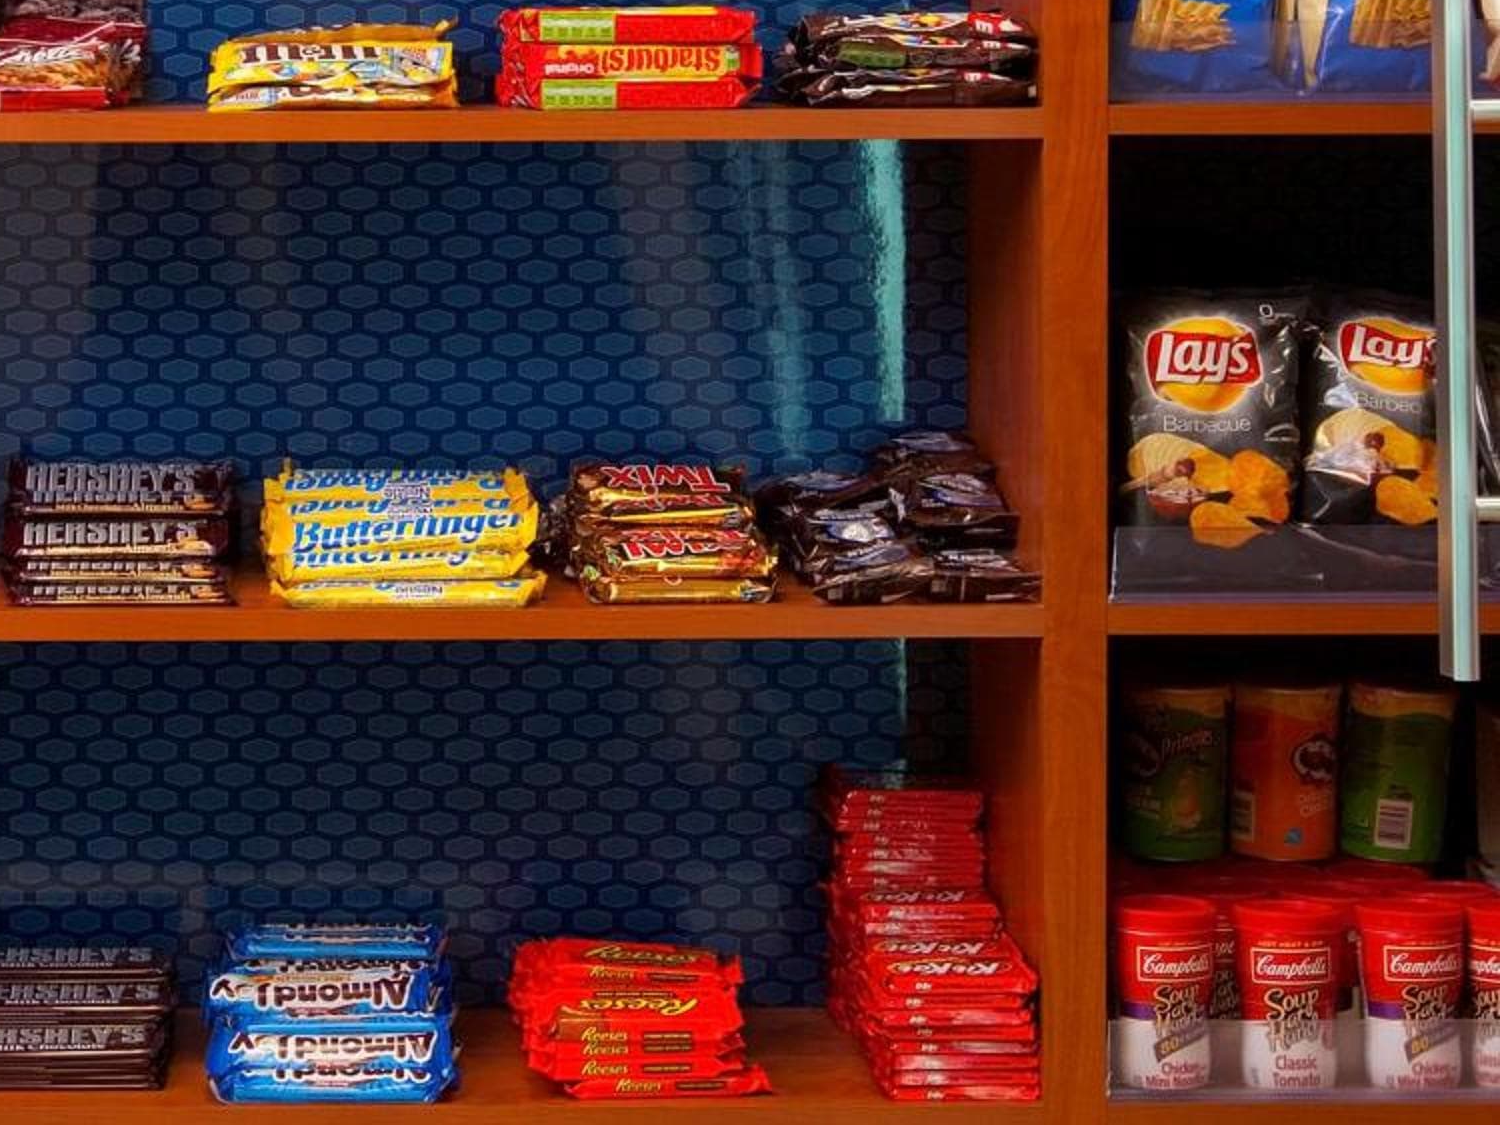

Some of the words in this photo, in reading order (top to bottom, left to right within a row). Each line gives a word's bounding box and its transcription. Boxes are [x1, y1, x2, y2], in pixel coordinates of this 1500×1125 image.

[600, 46, 722, 74] Starburst
[1155, 332, 1253, 385] Lay's
[1163, 415, 1252, 434] Barbecue
[25, 463, 196, 492] HERSHEY'S
[600, 464, 731, 492] TWIX
[23, 521, 199, 546] HERSHEY'S
[293, 513, 521, 554] Butterfinger
[273, 976, 413, 1009] Almond
[1154, 985, 1200, 1011] Soup
[1263, 988, 1320, 1020] Soup
[296, 1034, 435, 1062] Almond
[1275, 1055, 1318, 1071] Classic
[1273, 1072, 1321, 1088] Tomato
